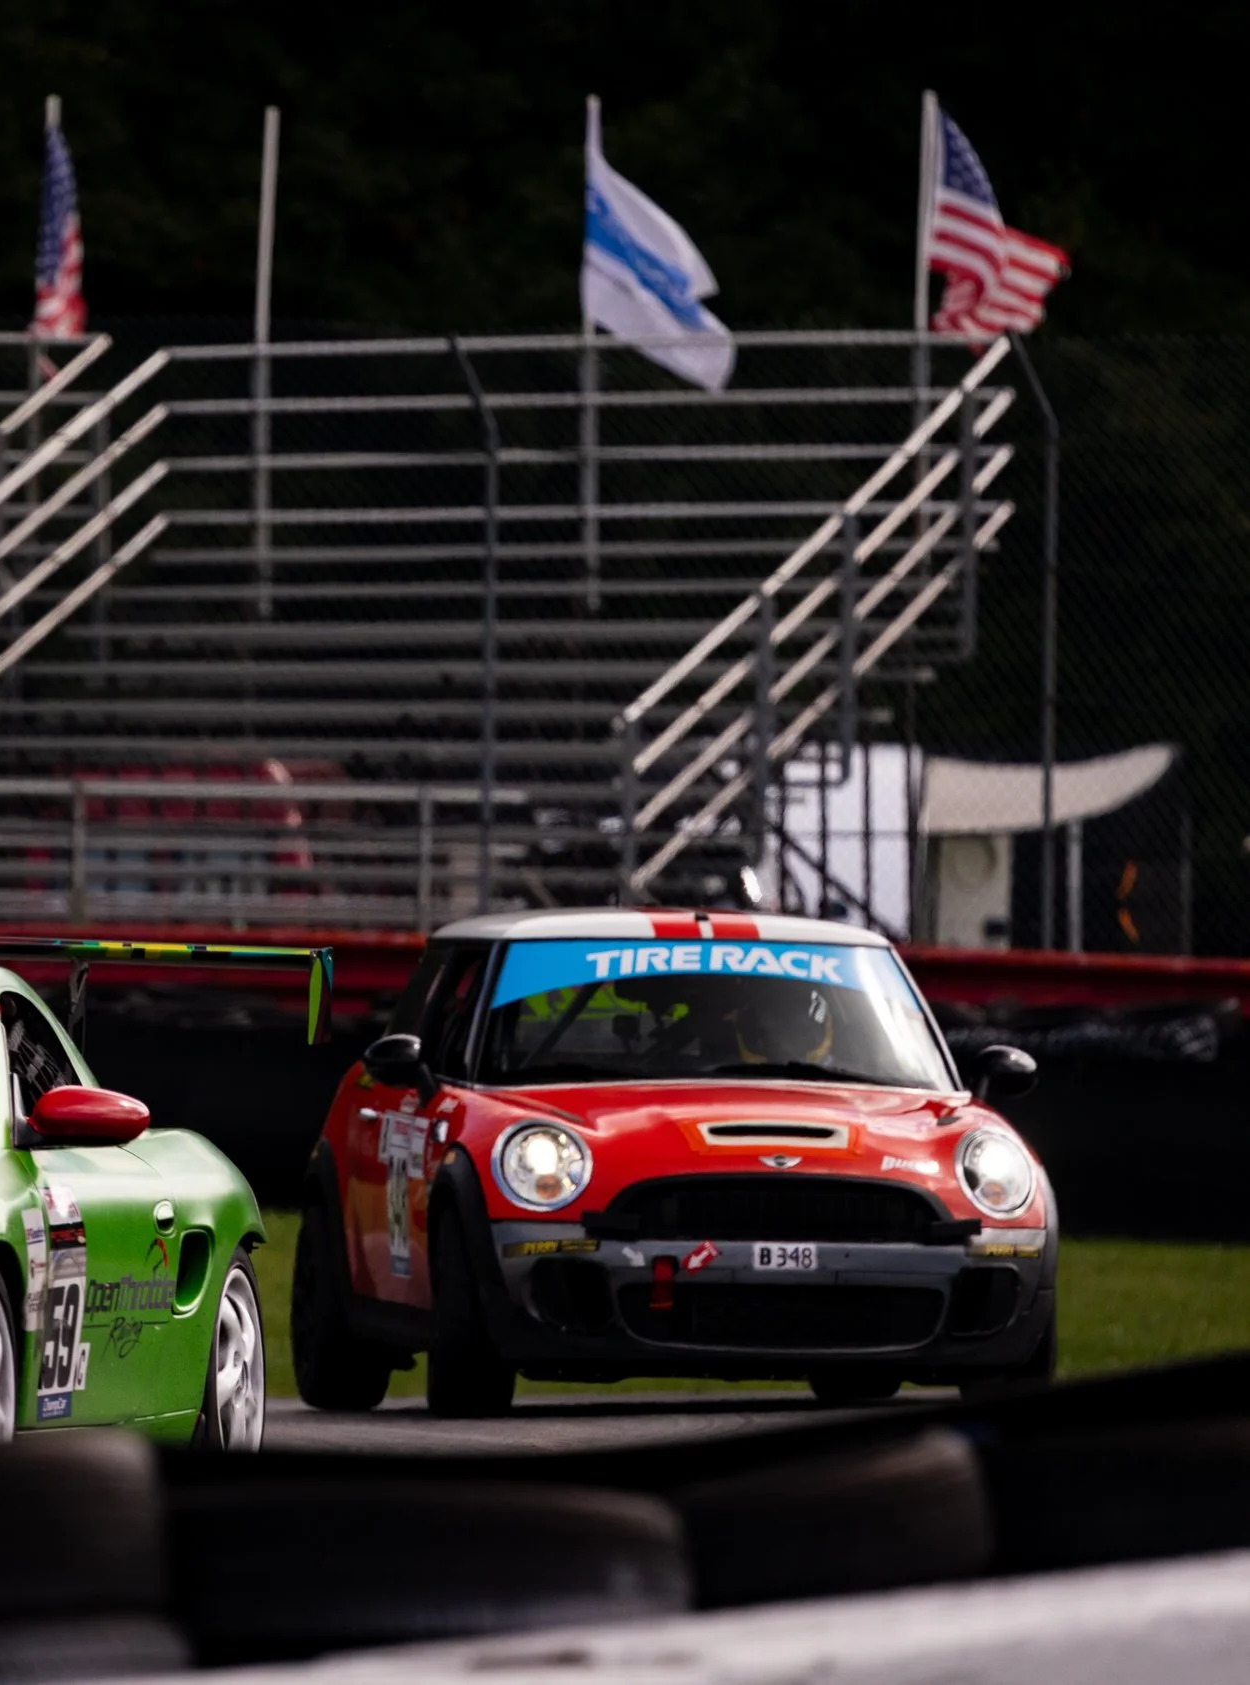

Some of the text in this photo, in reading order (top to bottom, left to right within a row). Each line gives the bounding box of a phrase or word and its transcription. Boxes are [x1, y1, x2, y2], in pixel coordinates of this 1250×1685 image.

[586, 944, 845, 982] TIRE RACK
[759, 1247, 813, 1269] B 348
